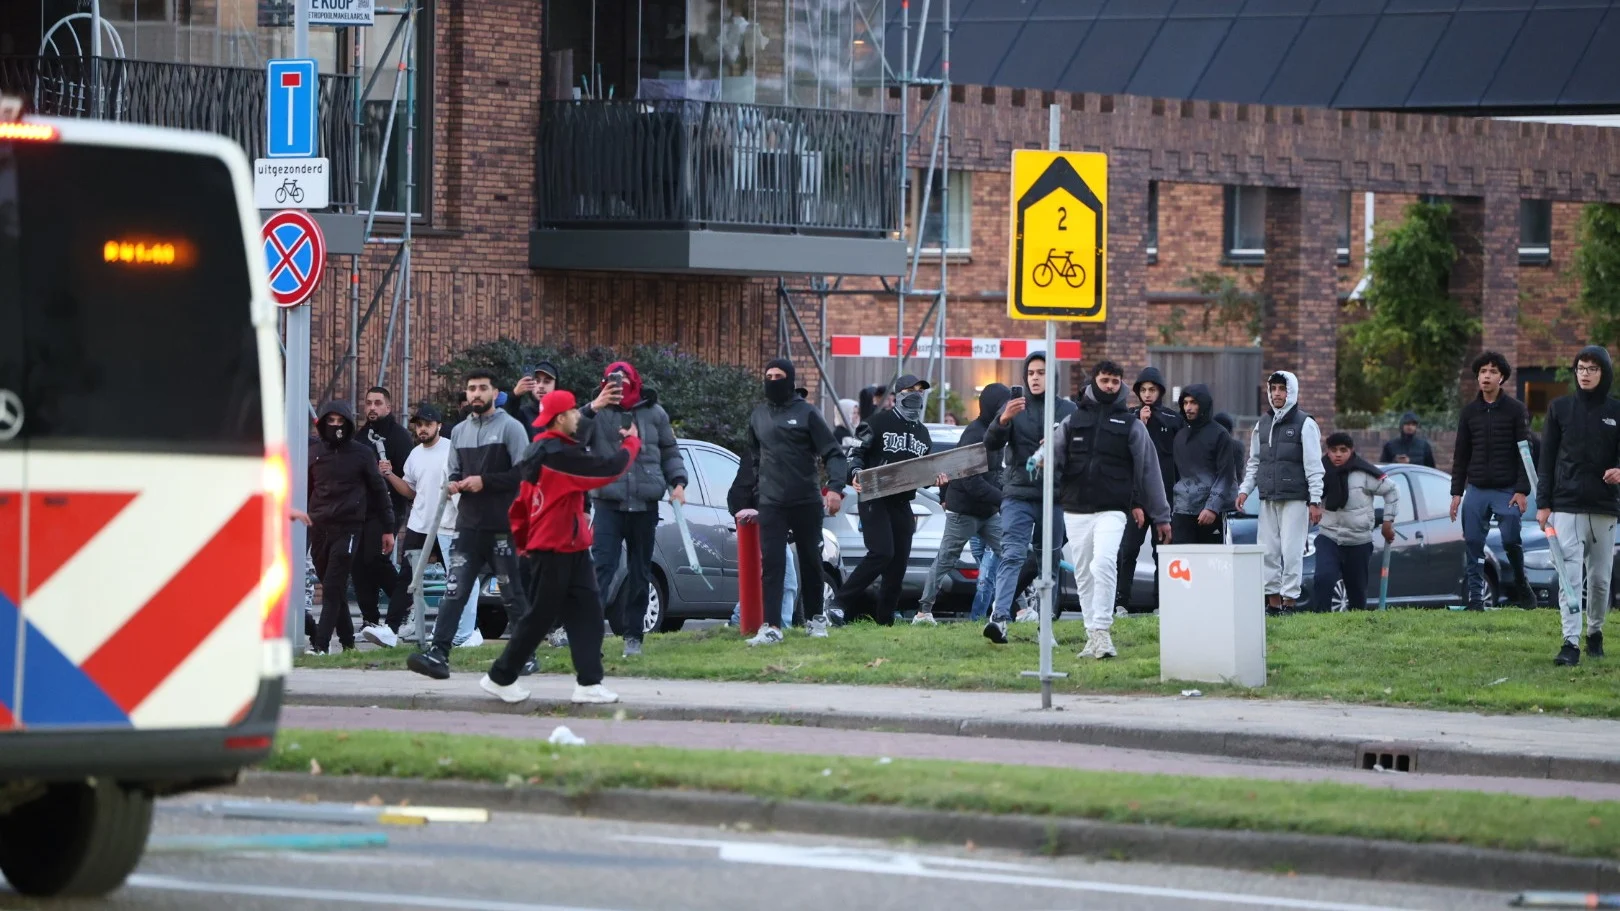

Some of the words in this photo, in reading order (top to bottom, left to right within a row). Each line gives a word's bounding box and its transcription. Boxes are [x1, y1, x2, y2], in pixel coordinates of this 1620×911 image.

[321, 0, 353, 10] KOOP
[308, 12, 371, 20] ETROPOOLMAKELAARS.NL
[258, 164, 323, 177] uitgezonderd
[1057, 206, 1067, 231] 2
